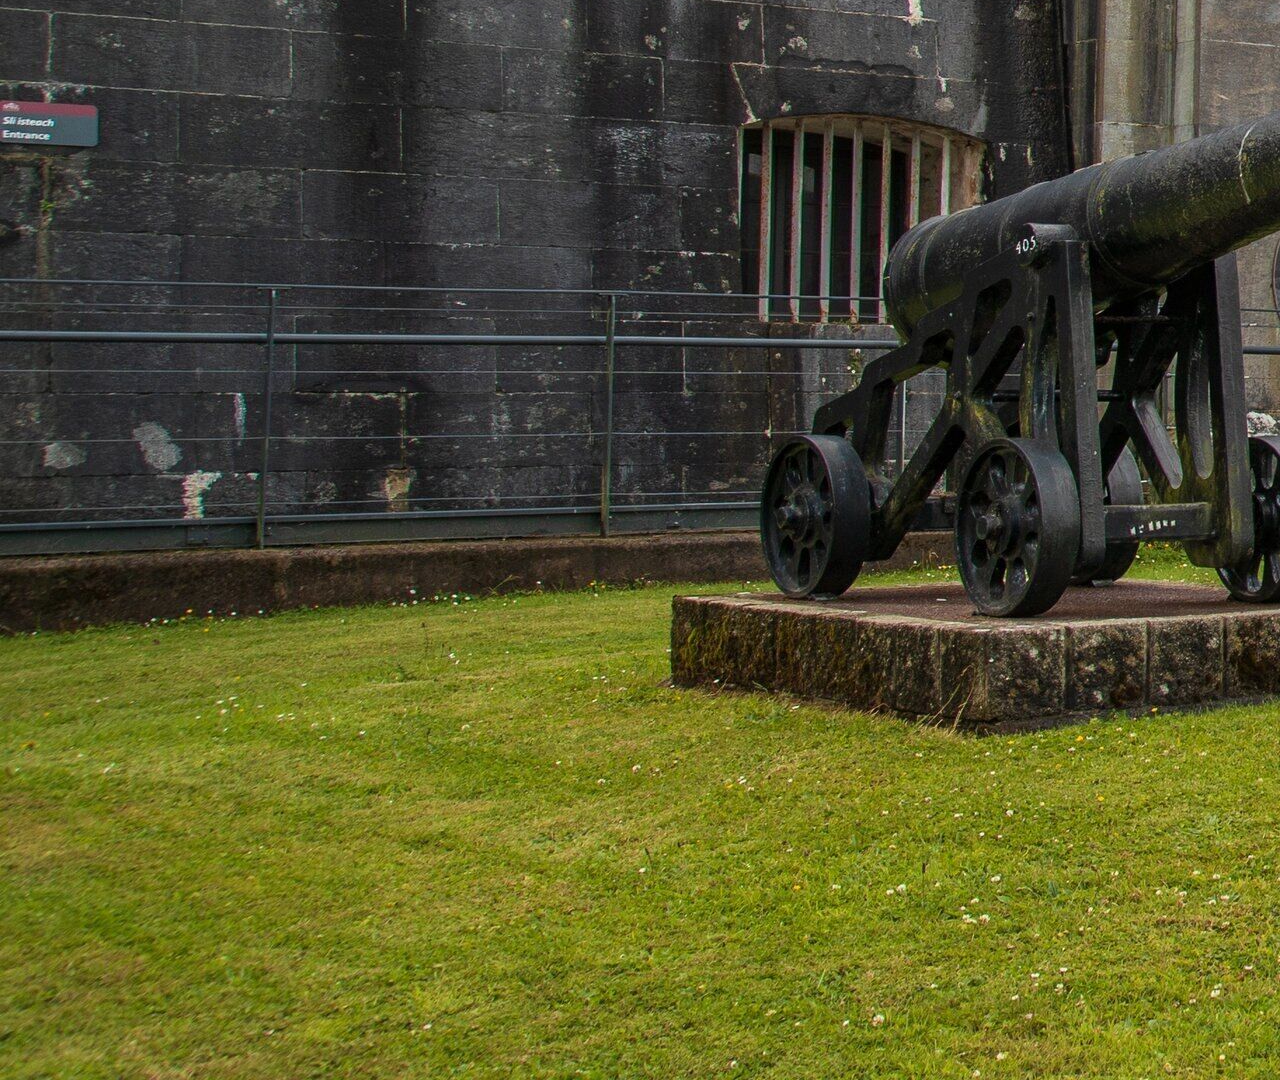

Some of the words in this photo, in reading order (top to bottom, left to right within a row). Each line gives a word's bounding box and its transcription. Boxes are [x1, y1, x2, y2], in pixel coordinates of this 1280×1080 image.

[17, 117, 55, 127] isteach
[2, 130, 51, 140] Entrance
[1015, 236, 1036, 254] 405
